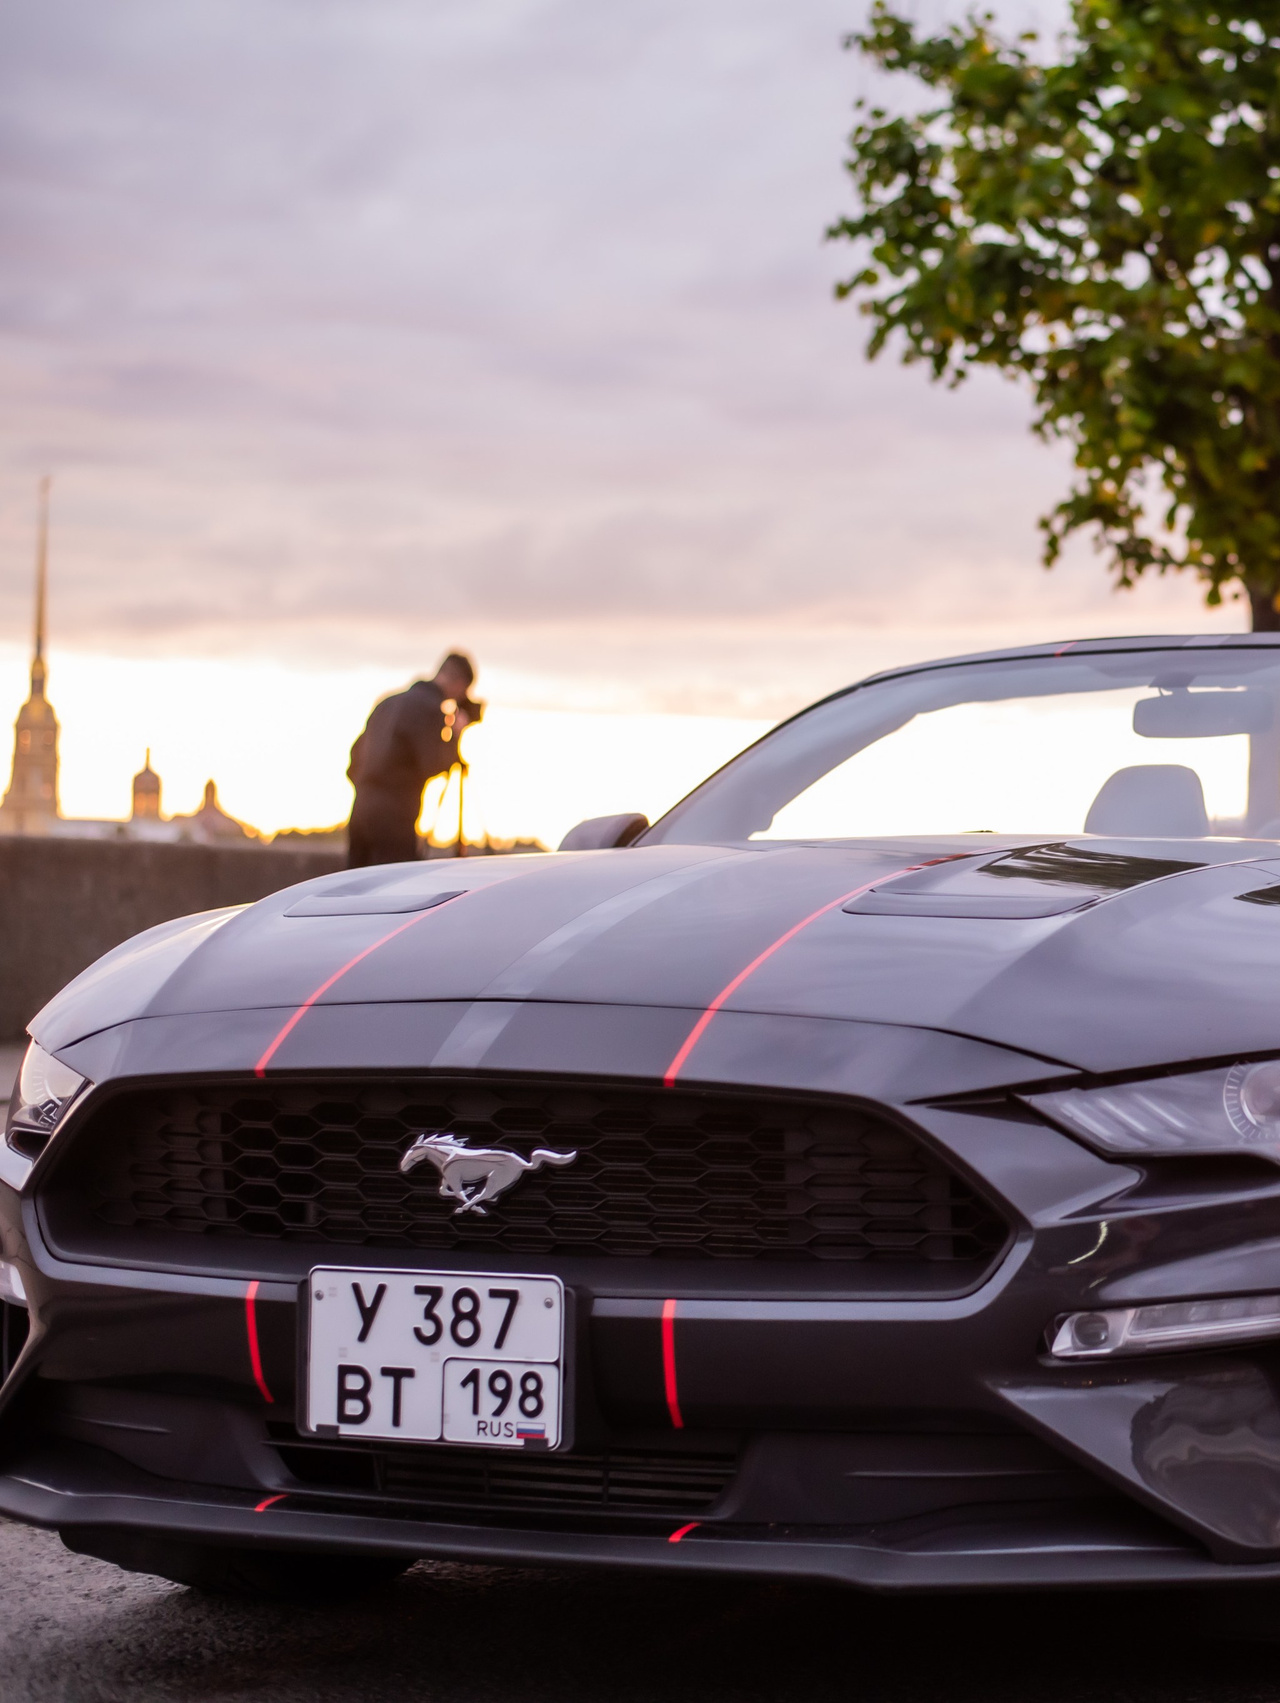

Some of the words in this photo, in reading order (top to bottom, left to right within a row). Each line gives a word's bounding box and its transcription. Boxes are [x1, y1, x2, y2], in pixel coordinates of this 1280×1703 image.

[413, 1285, 519, 1349] 387
[460, 1368, 544, 1418] 198
[476, 1420, 514, 1438] RUS
